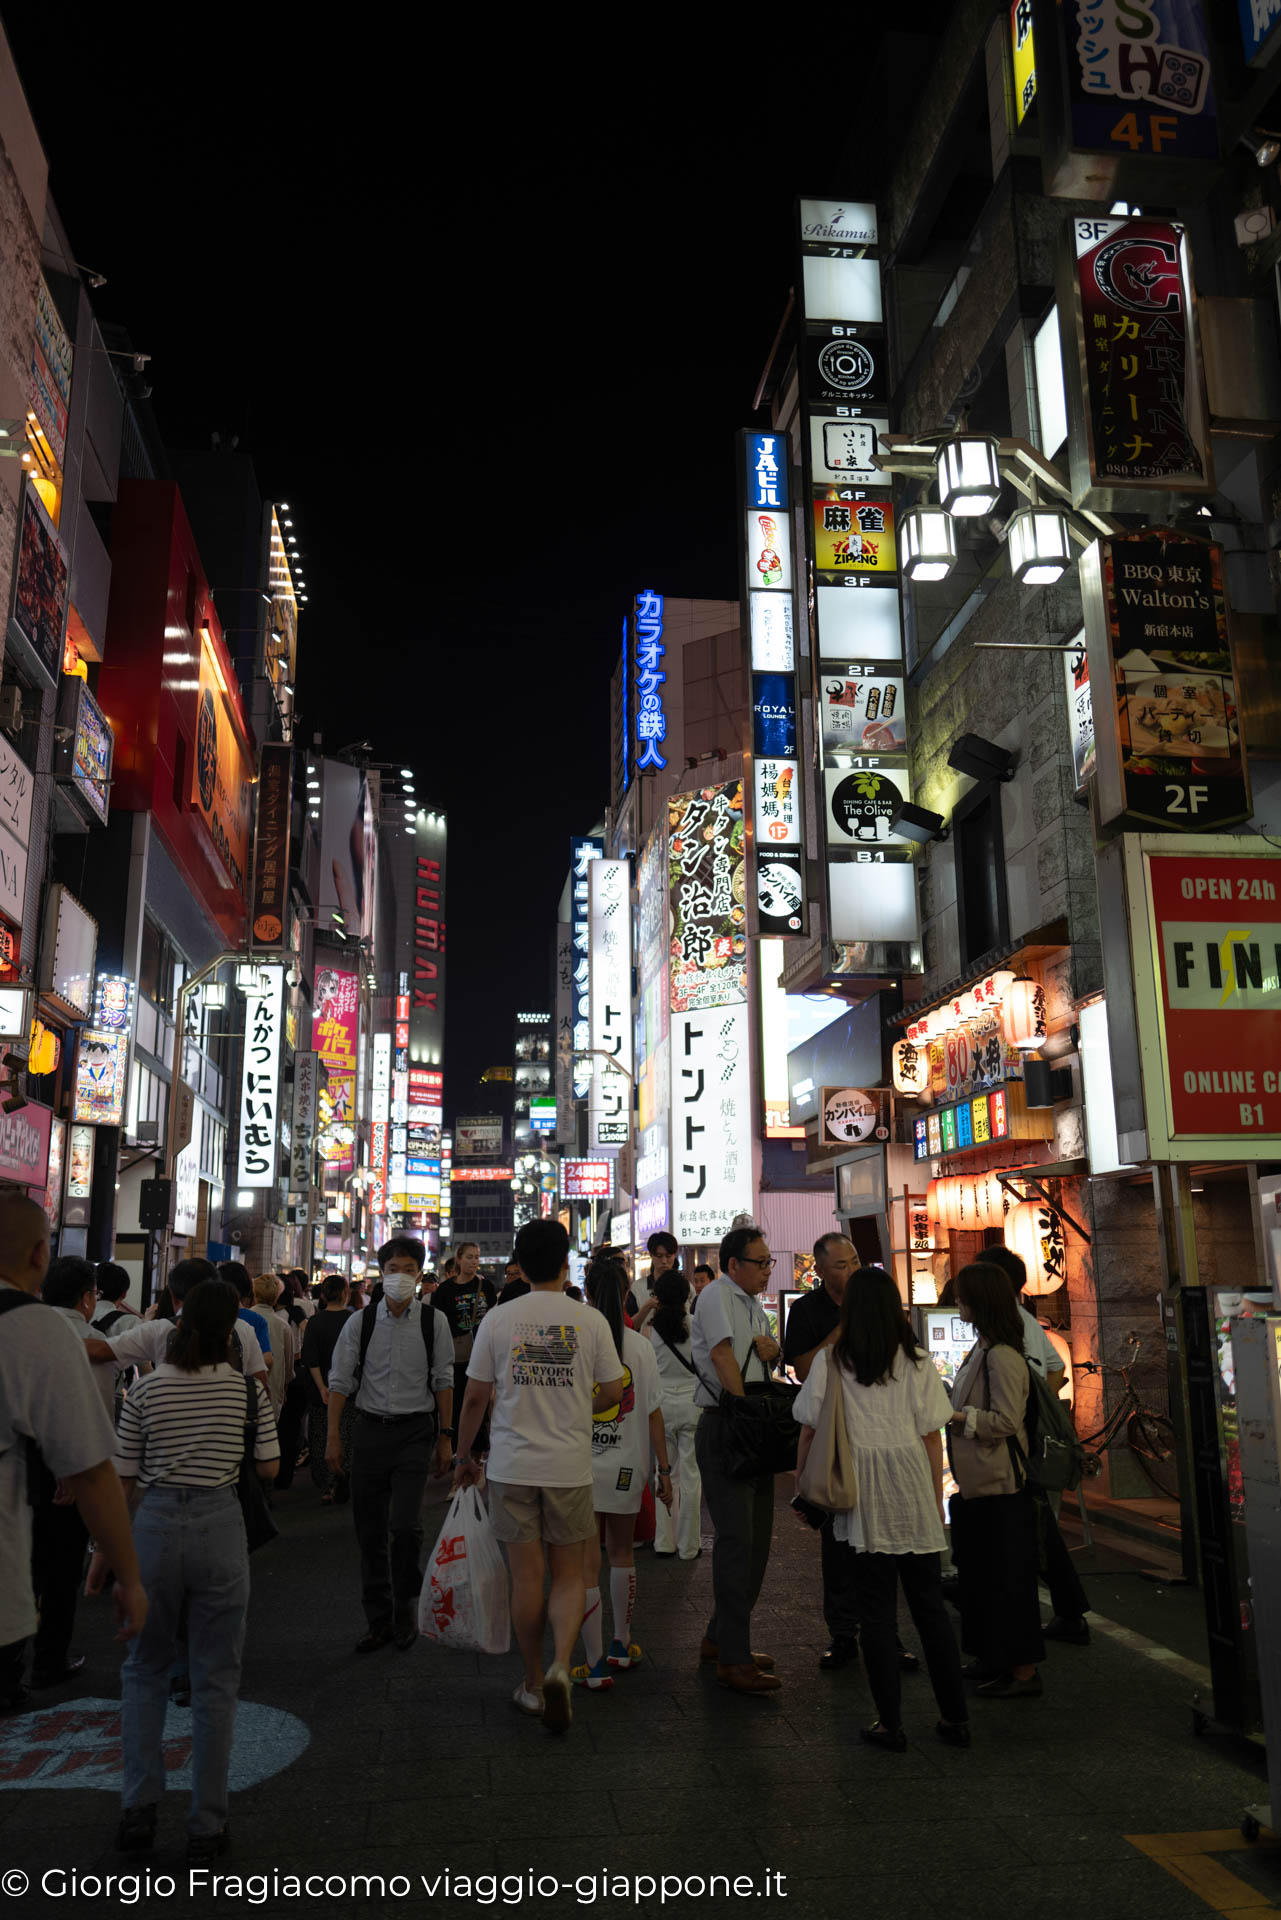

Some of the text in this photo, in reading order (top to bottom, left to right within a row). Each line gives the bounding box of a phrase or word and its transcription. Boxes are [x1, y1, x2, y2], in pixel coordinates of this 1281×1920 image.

[1110, 112, 1179, 153] 4F
[1078, 221, 1109, 241] 3F
[828, 247, 854, 258] 7F
[832, 326, 857, 336] 6F
[1111, 315, 1153, 463] カリーナ
[836, 406, 862, 417] 5F
[755, 437, 781, 506] JAビル
[840, 490, 866, 501] 4F
[823, 505, 885, 533] 麻雀
[844, 576, 871, 587] 3F
[1122, 564, 1203, 583] BBQ 東京
[1121, 588, 1211, 610] Walton's
[1143, 624, 1195, 639] 新宿本店
[636, 590, 667, 770] カラオケの鉄人
[848, 665, 876, 676] 2F
[754, 703, 796, 714] ROYAL
[784, 745, 795, 754] 2F
[853, 757, 880, 768] 1F
[1164, 784, 1209, 814] 2F
[843, 805, 893, 816] The Olive
[769, 824, 789, 837] 1F
[713, 794, 732, 917] 牛タン専門店
[856, 851, 885, 863] B1
[1181, 877, 1276, 900] OPEN 24h
[1173, 941, 1281, 989] FIN
[1184, 1070, 1281, 1093] ONLINE C
[682, 1022, 707, 1200] トントン
[1239, 1103, 1264, 1126] B1
[244, 1071, 273, 1175] にいむら
[567, 1164, 608, 1178] 24時間
[567, 1179, 608, 1193] 営業中
